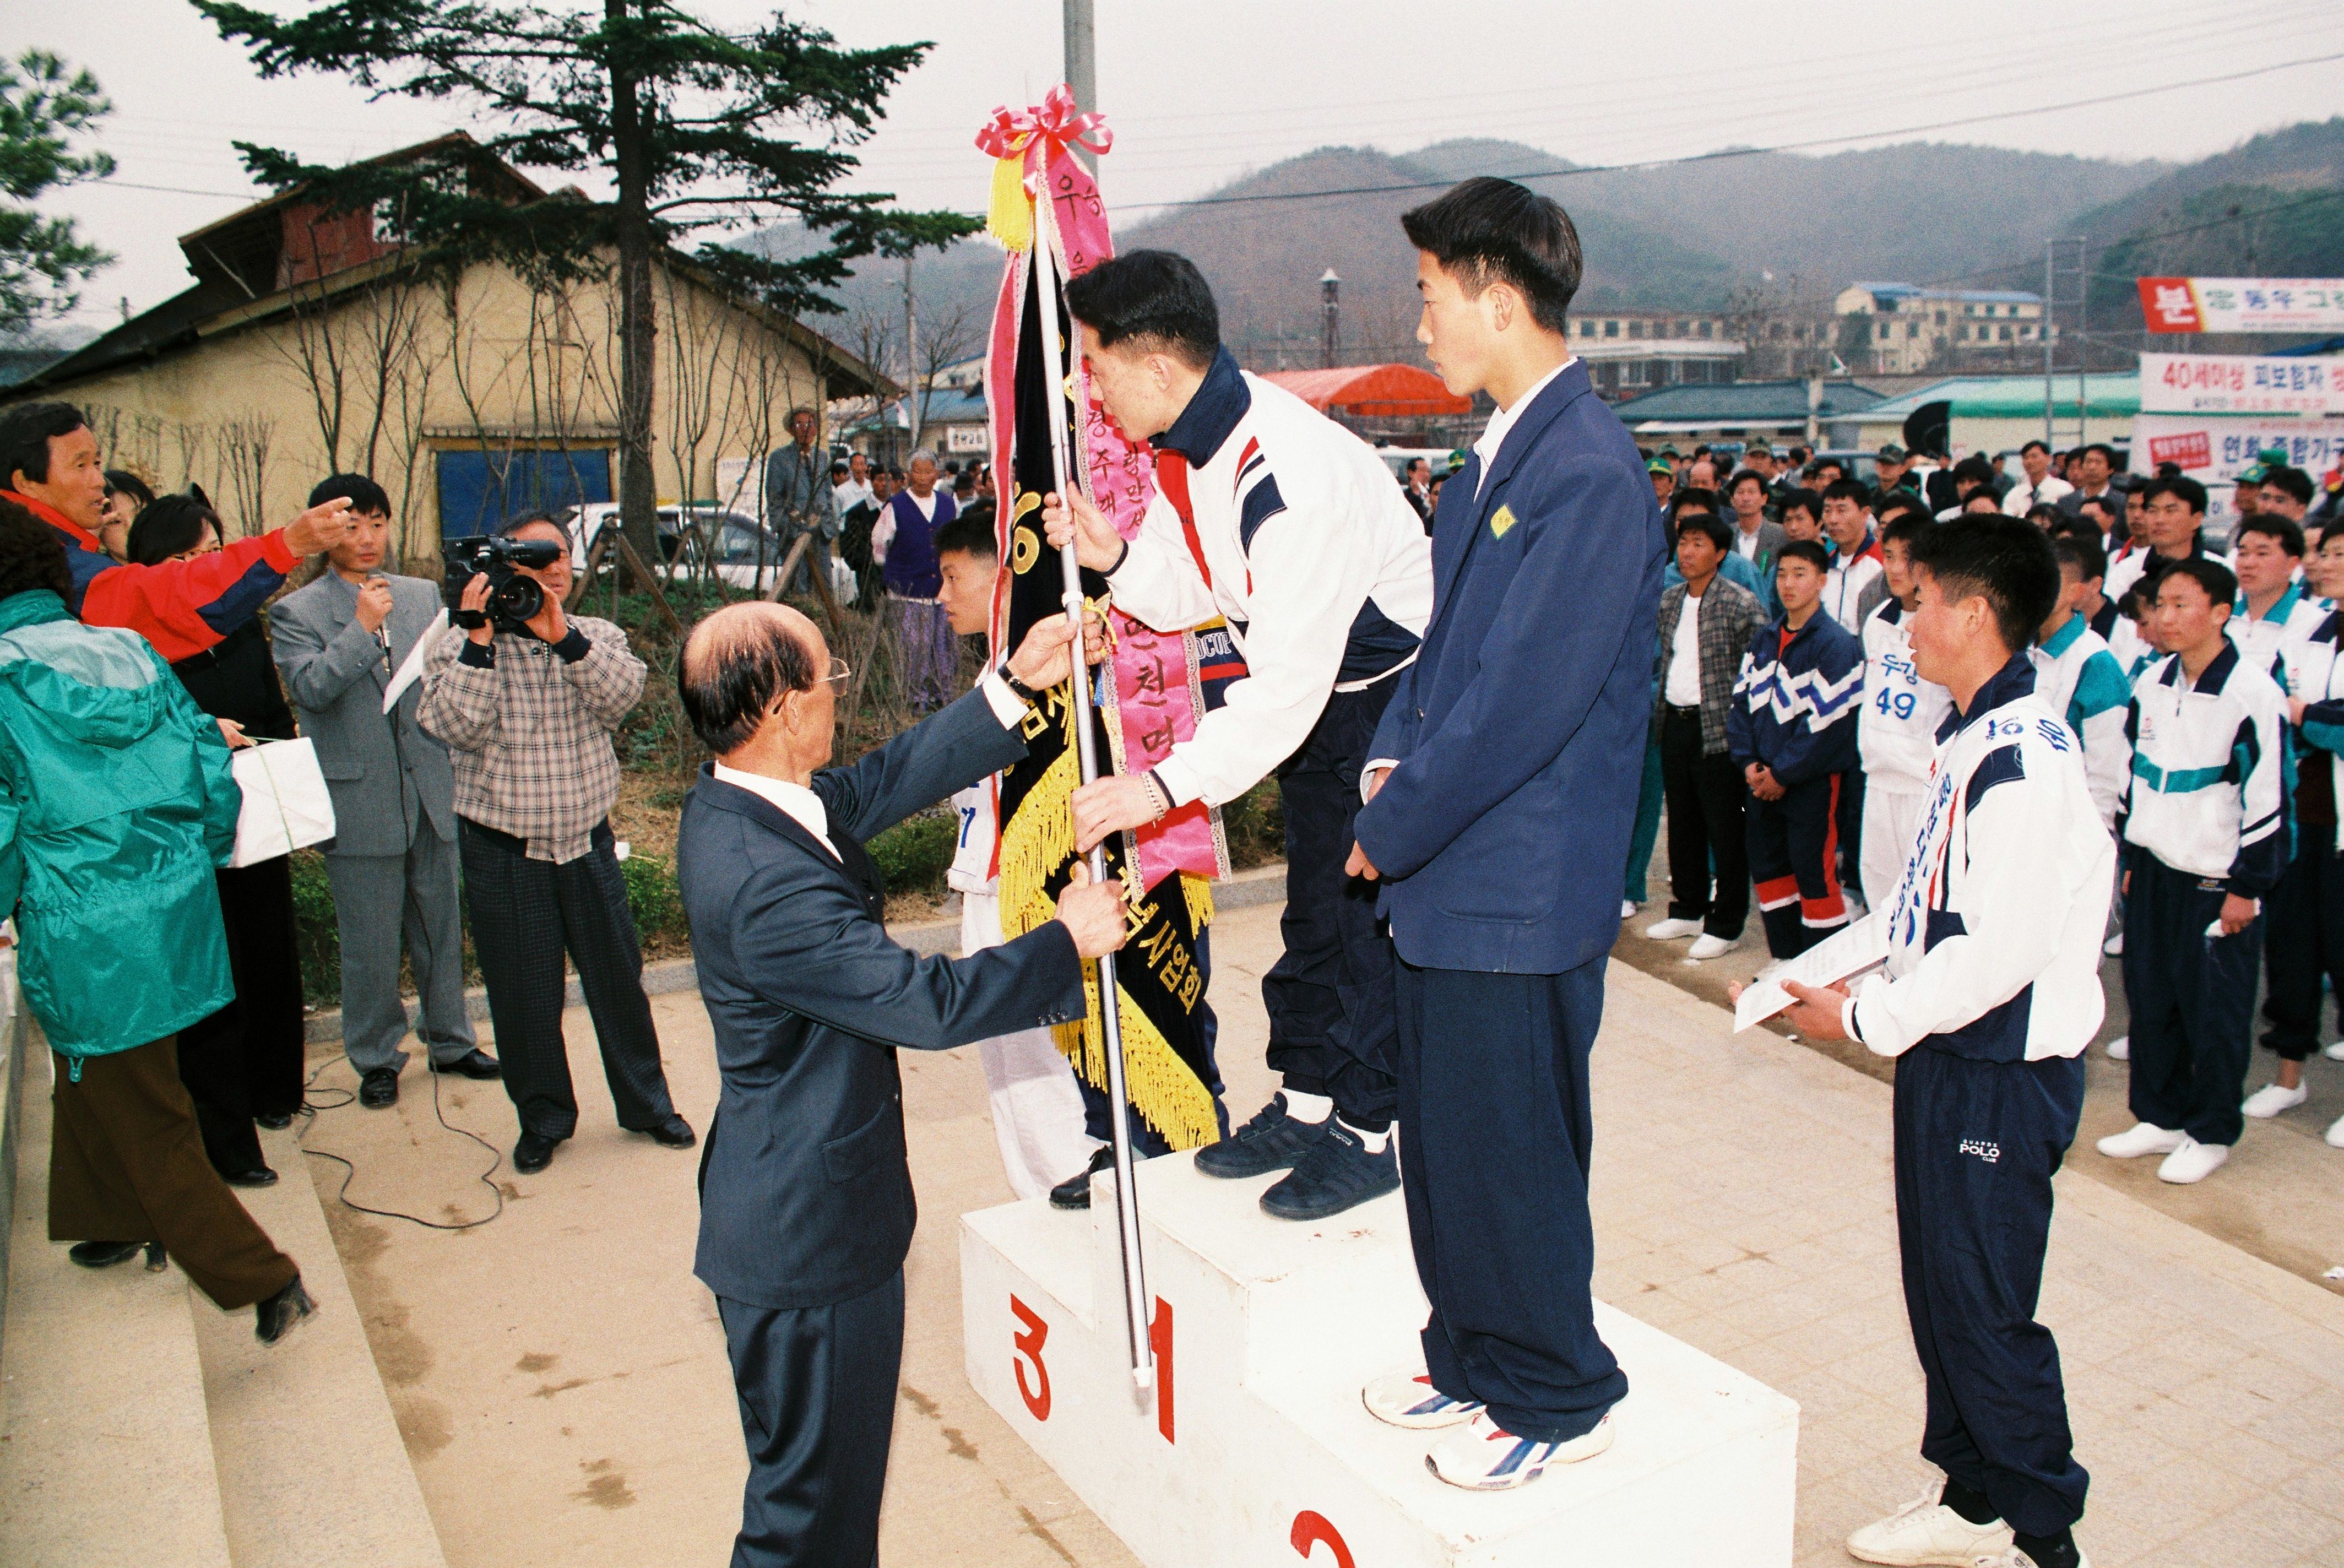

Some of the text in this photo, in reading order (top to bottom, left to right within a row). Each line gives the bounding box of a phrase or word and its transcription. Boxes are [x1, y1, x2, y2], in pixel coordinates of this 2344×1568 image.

[2163, 361, 2245, 392] 40세이상
[1876, 686, 1917, 720] 49
[1138, 919, 1202, 1016] 사업회
[1959, 1143, 2000, 1157] POLO
[1010, 1293, 1051, 1421] 3
[1149, 1294, 1174, 1445] 1
